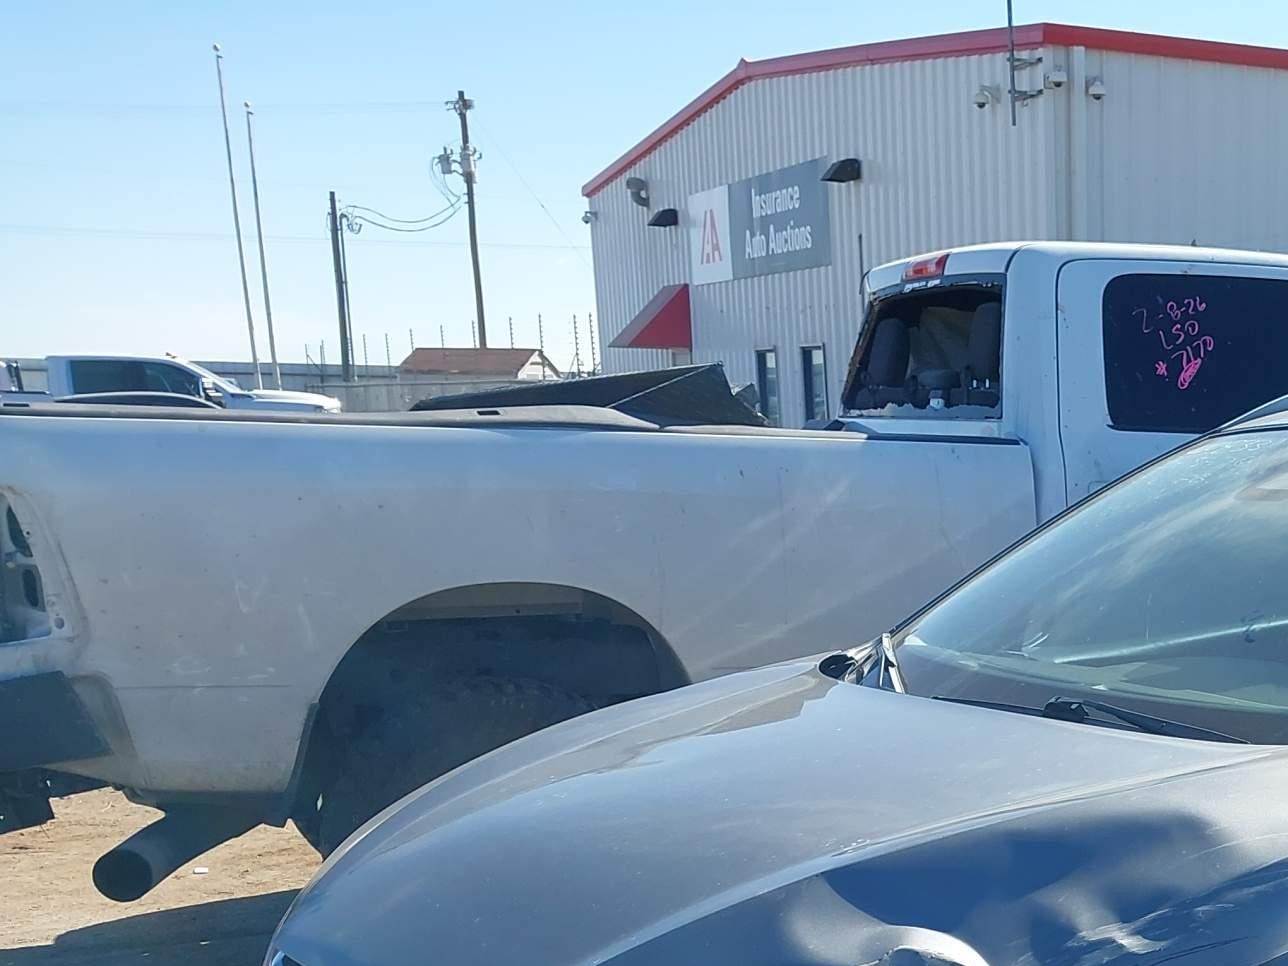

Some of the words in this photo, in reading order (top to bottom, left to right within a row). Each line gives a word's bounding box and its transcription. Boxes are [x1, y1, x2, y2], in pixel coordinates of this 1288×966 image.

[751, 185, 800, 218] Insurance
[745, 229, 767, 259] Auto
[768, 219, 812, 256] Auctions
